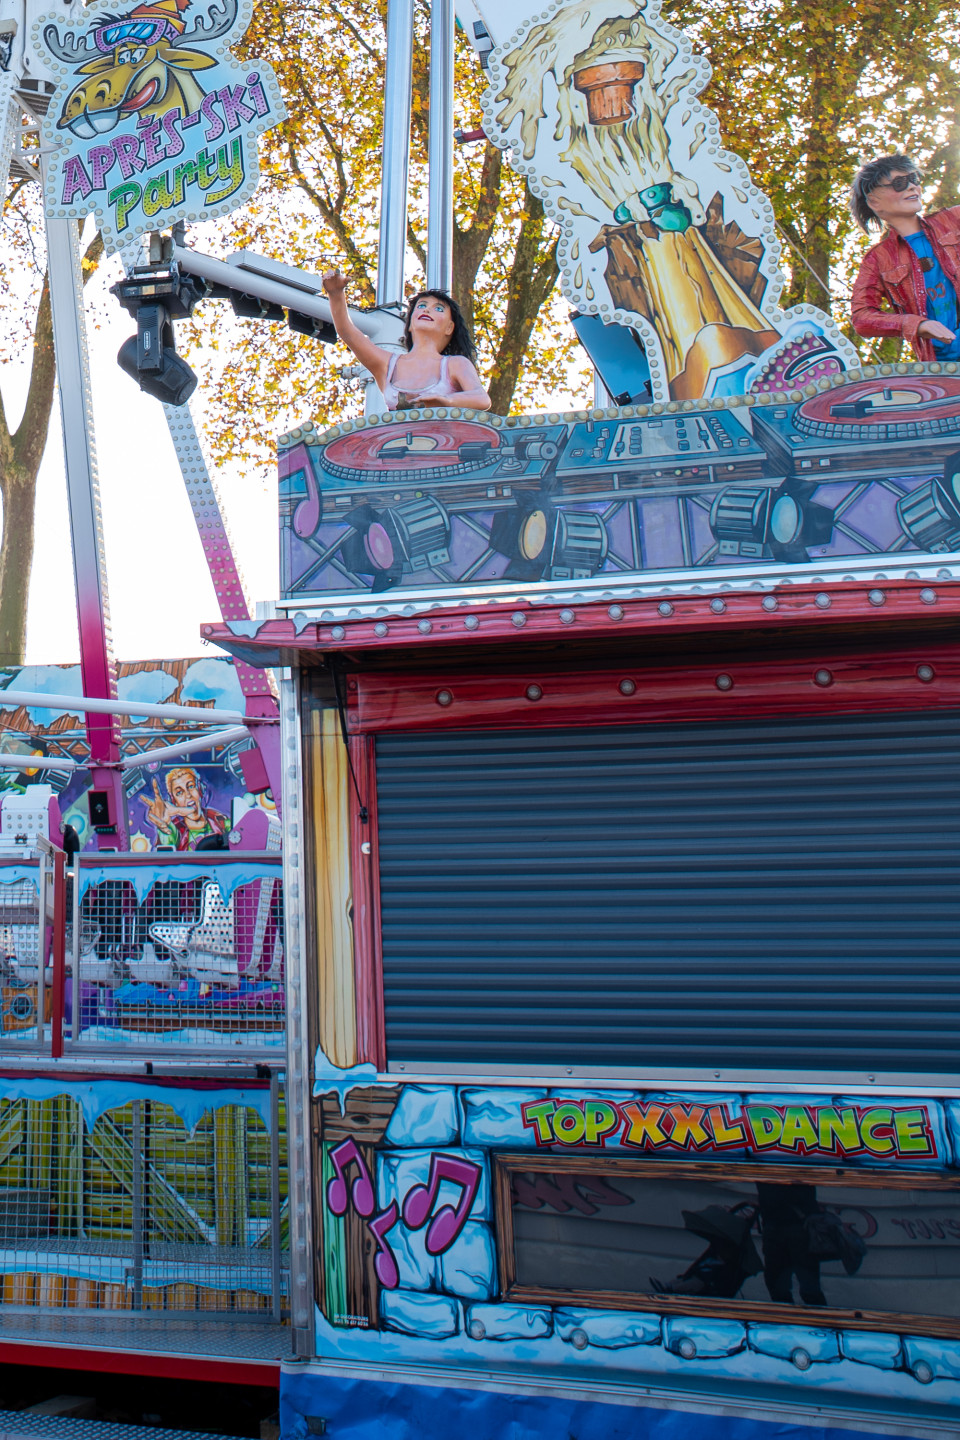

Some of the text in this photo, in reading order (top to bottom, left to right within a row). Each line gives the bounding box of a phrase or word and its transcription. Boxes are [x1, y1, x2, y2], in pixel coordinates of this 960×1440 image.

[108, 134, 246, 232] Party
[926, 282, 946, 301] DJ
[523, 1100, 935, 1157] TOP XXL DANCE
